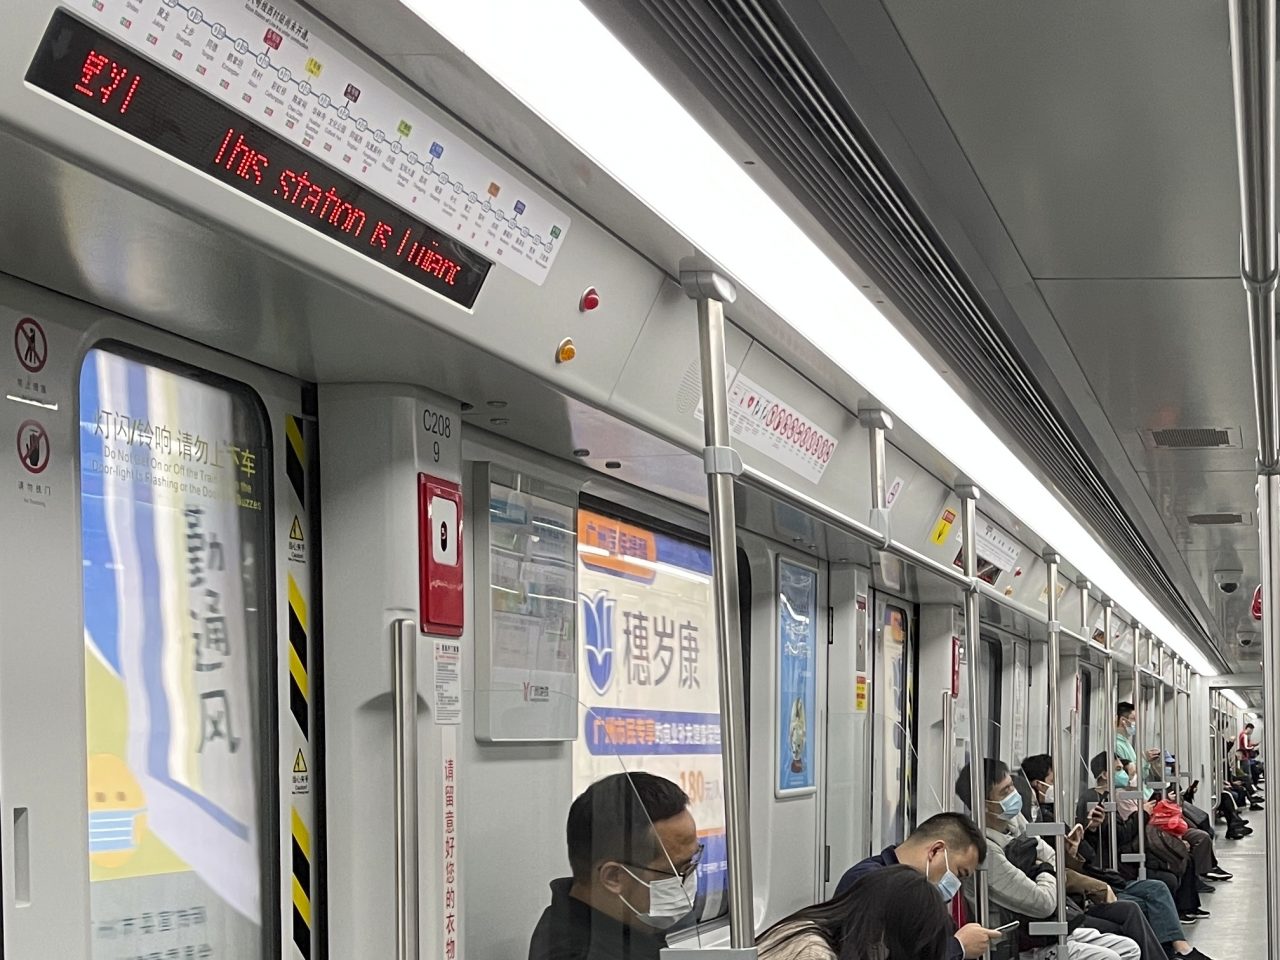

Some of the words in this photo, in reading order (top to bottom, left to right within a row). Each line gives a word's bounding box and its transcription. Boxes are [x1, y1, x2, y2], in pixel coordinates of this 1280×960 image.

[423, 409, 451, 438] C208
[433, 441, 440, 462] 9
[622, 611, 701, 690] 穗岁康
